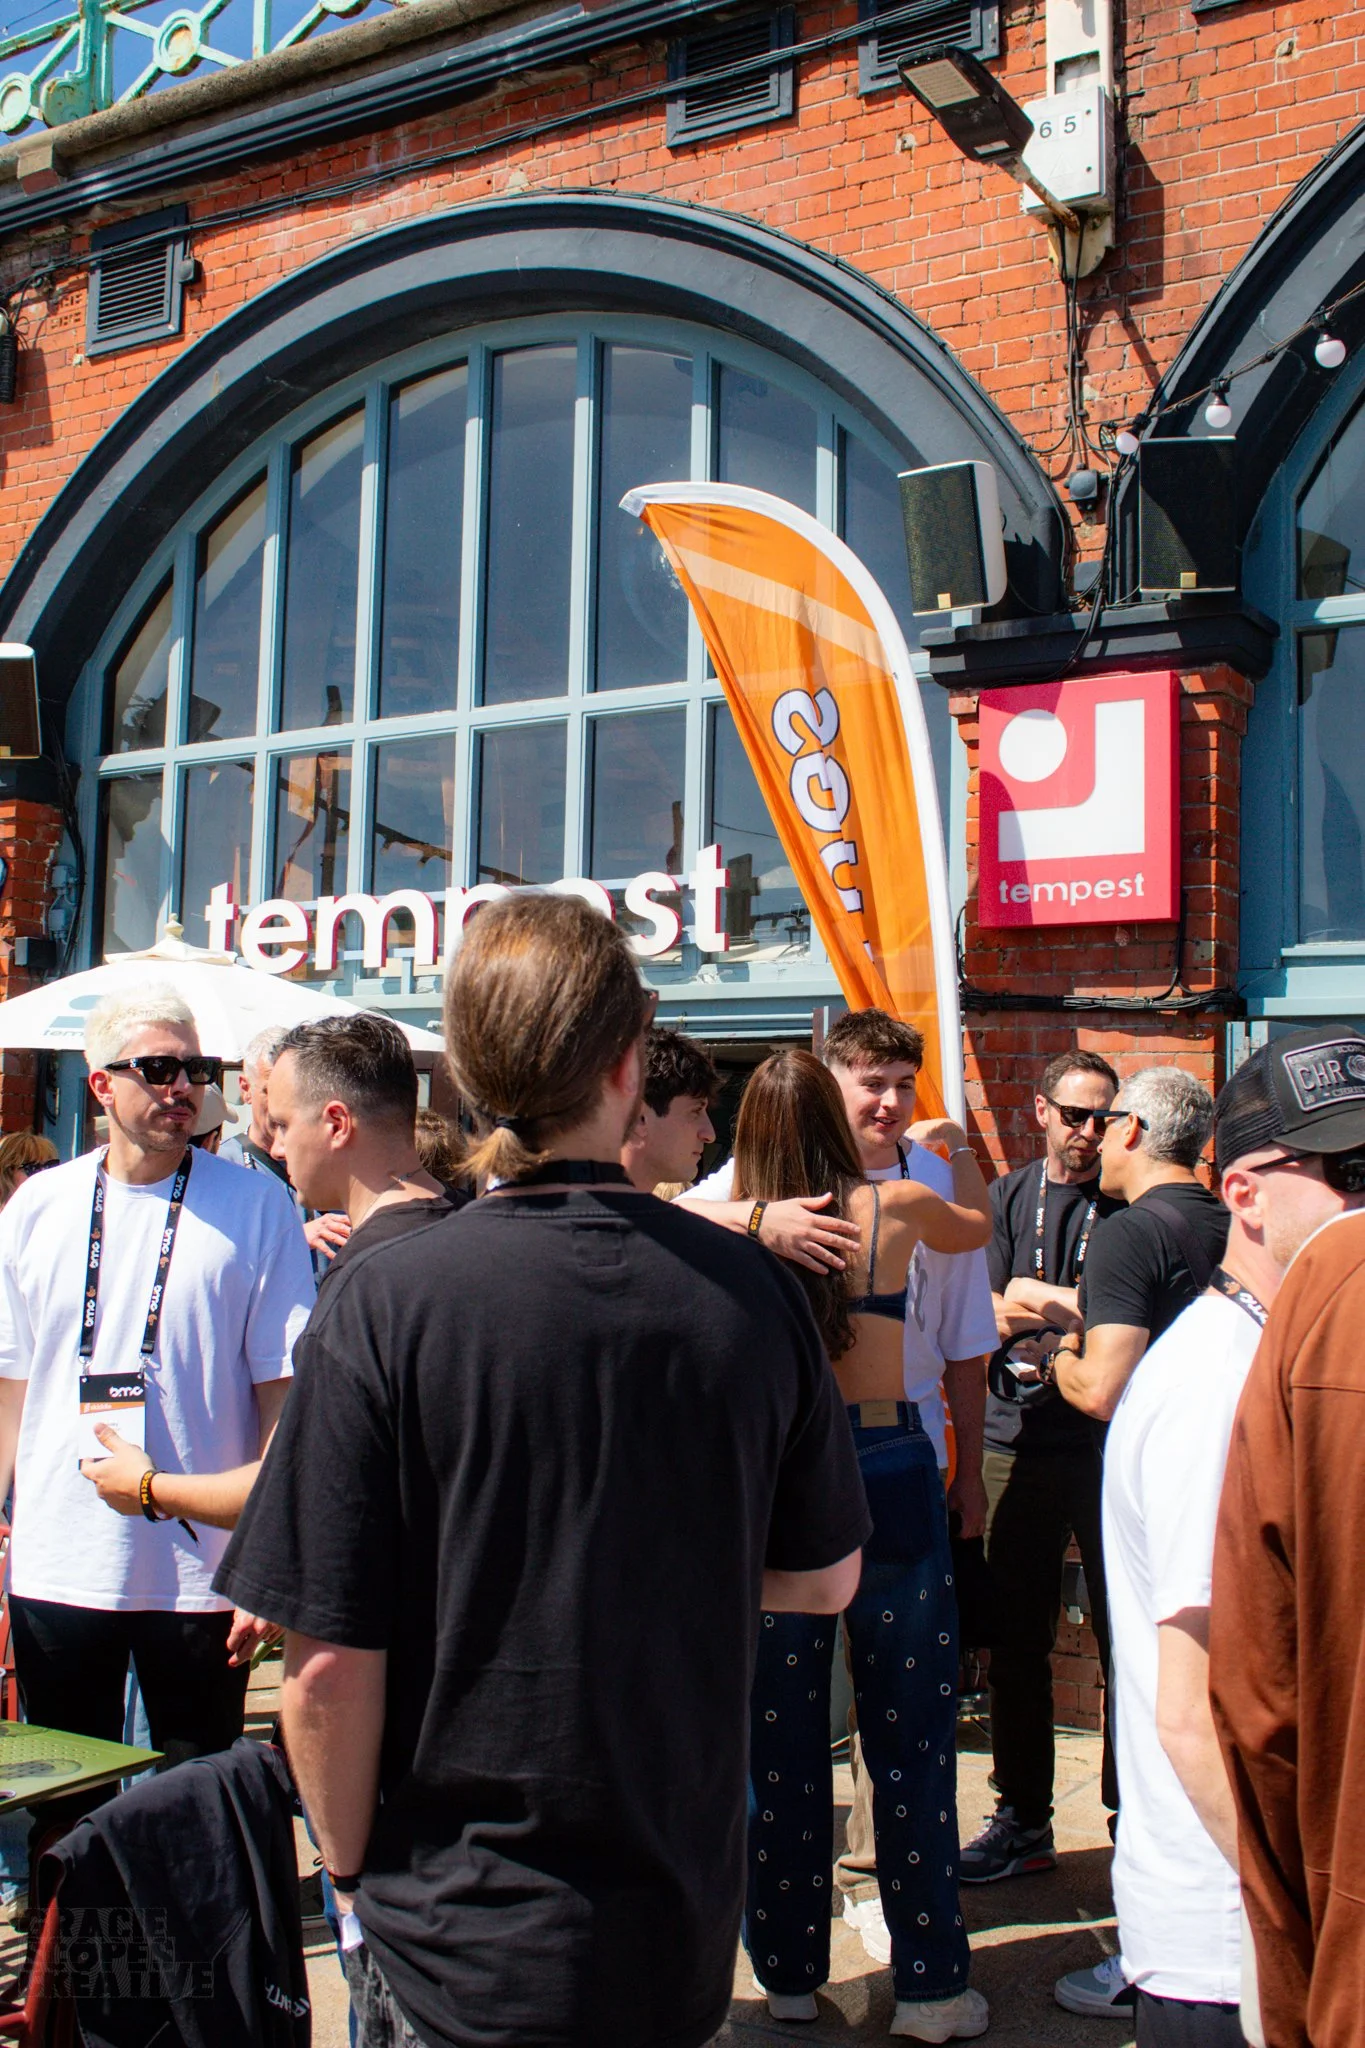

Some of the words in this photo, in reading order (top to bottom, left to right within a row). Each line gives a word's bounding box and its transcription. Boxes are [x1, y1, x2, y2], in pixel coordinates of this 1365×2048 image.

[1040, 115, 1077, 138] 65
[998, 872, 1145, 907] tempest
[204, 843, 731, 975] temst
